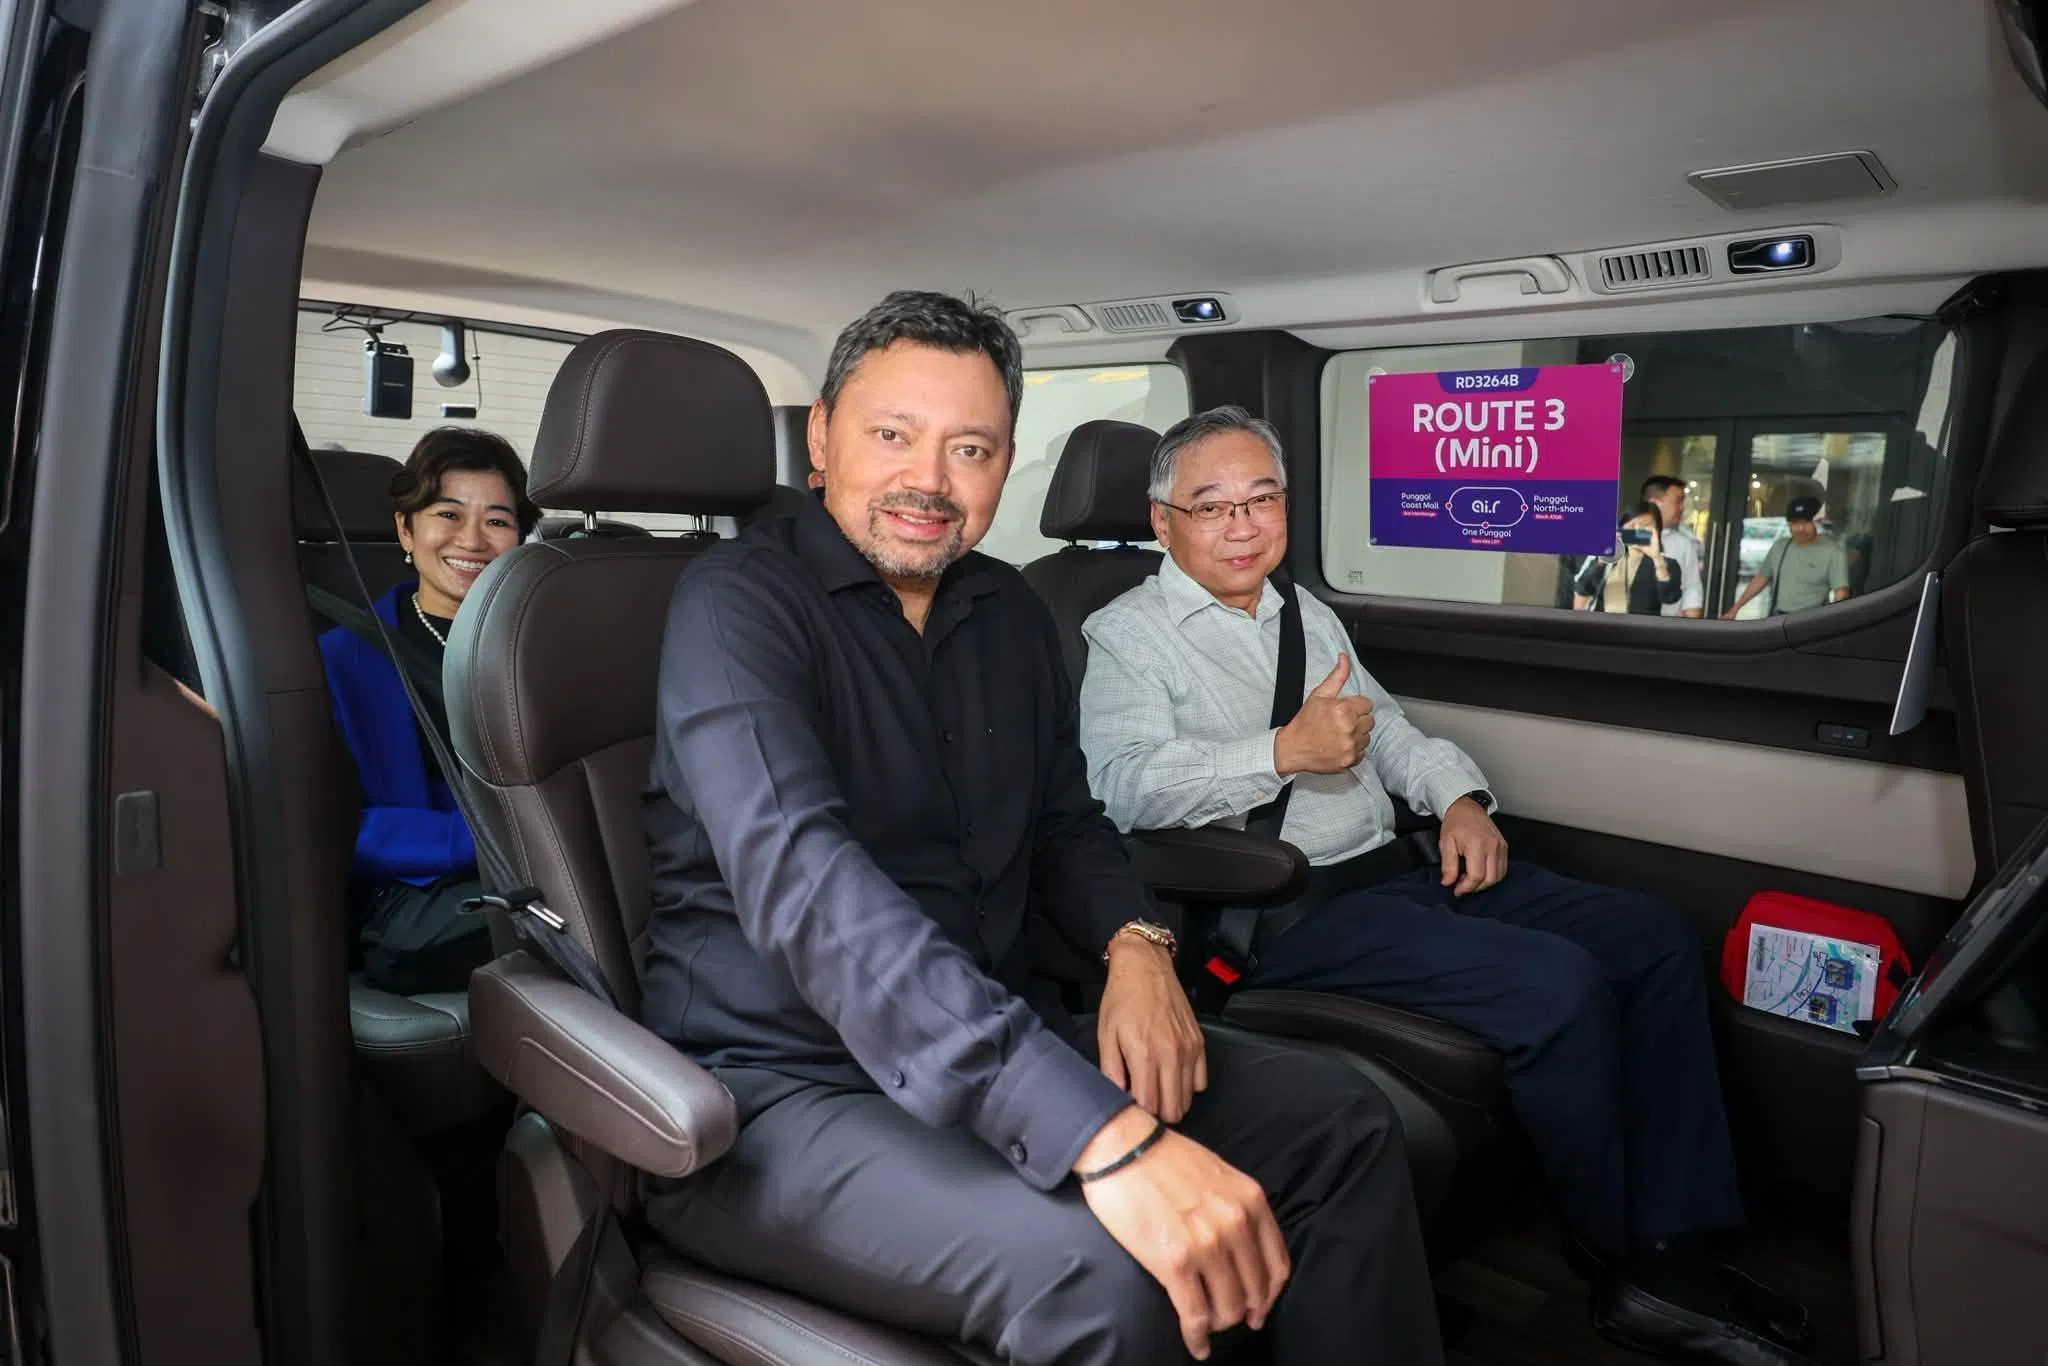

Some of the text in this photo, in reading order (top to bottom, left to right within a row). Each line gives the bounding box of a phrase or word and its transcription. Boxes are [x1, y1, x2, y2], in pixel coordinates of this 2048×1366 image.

[1455, 374, 1519, 389] RD3264B
[1413, 398, 1565, 433] ROUTE 3
[1435, 435, 1539, 473] (Mini)
[1401, 492, 1432, 502] Punggol
[1533, 495, 1568, 505] Punggol
[1401, 501, 1439, 510] Coast Mall
[1533, 504, 1584, 513] North-shore
[1462, 528, 1511, 539] One Punggol
